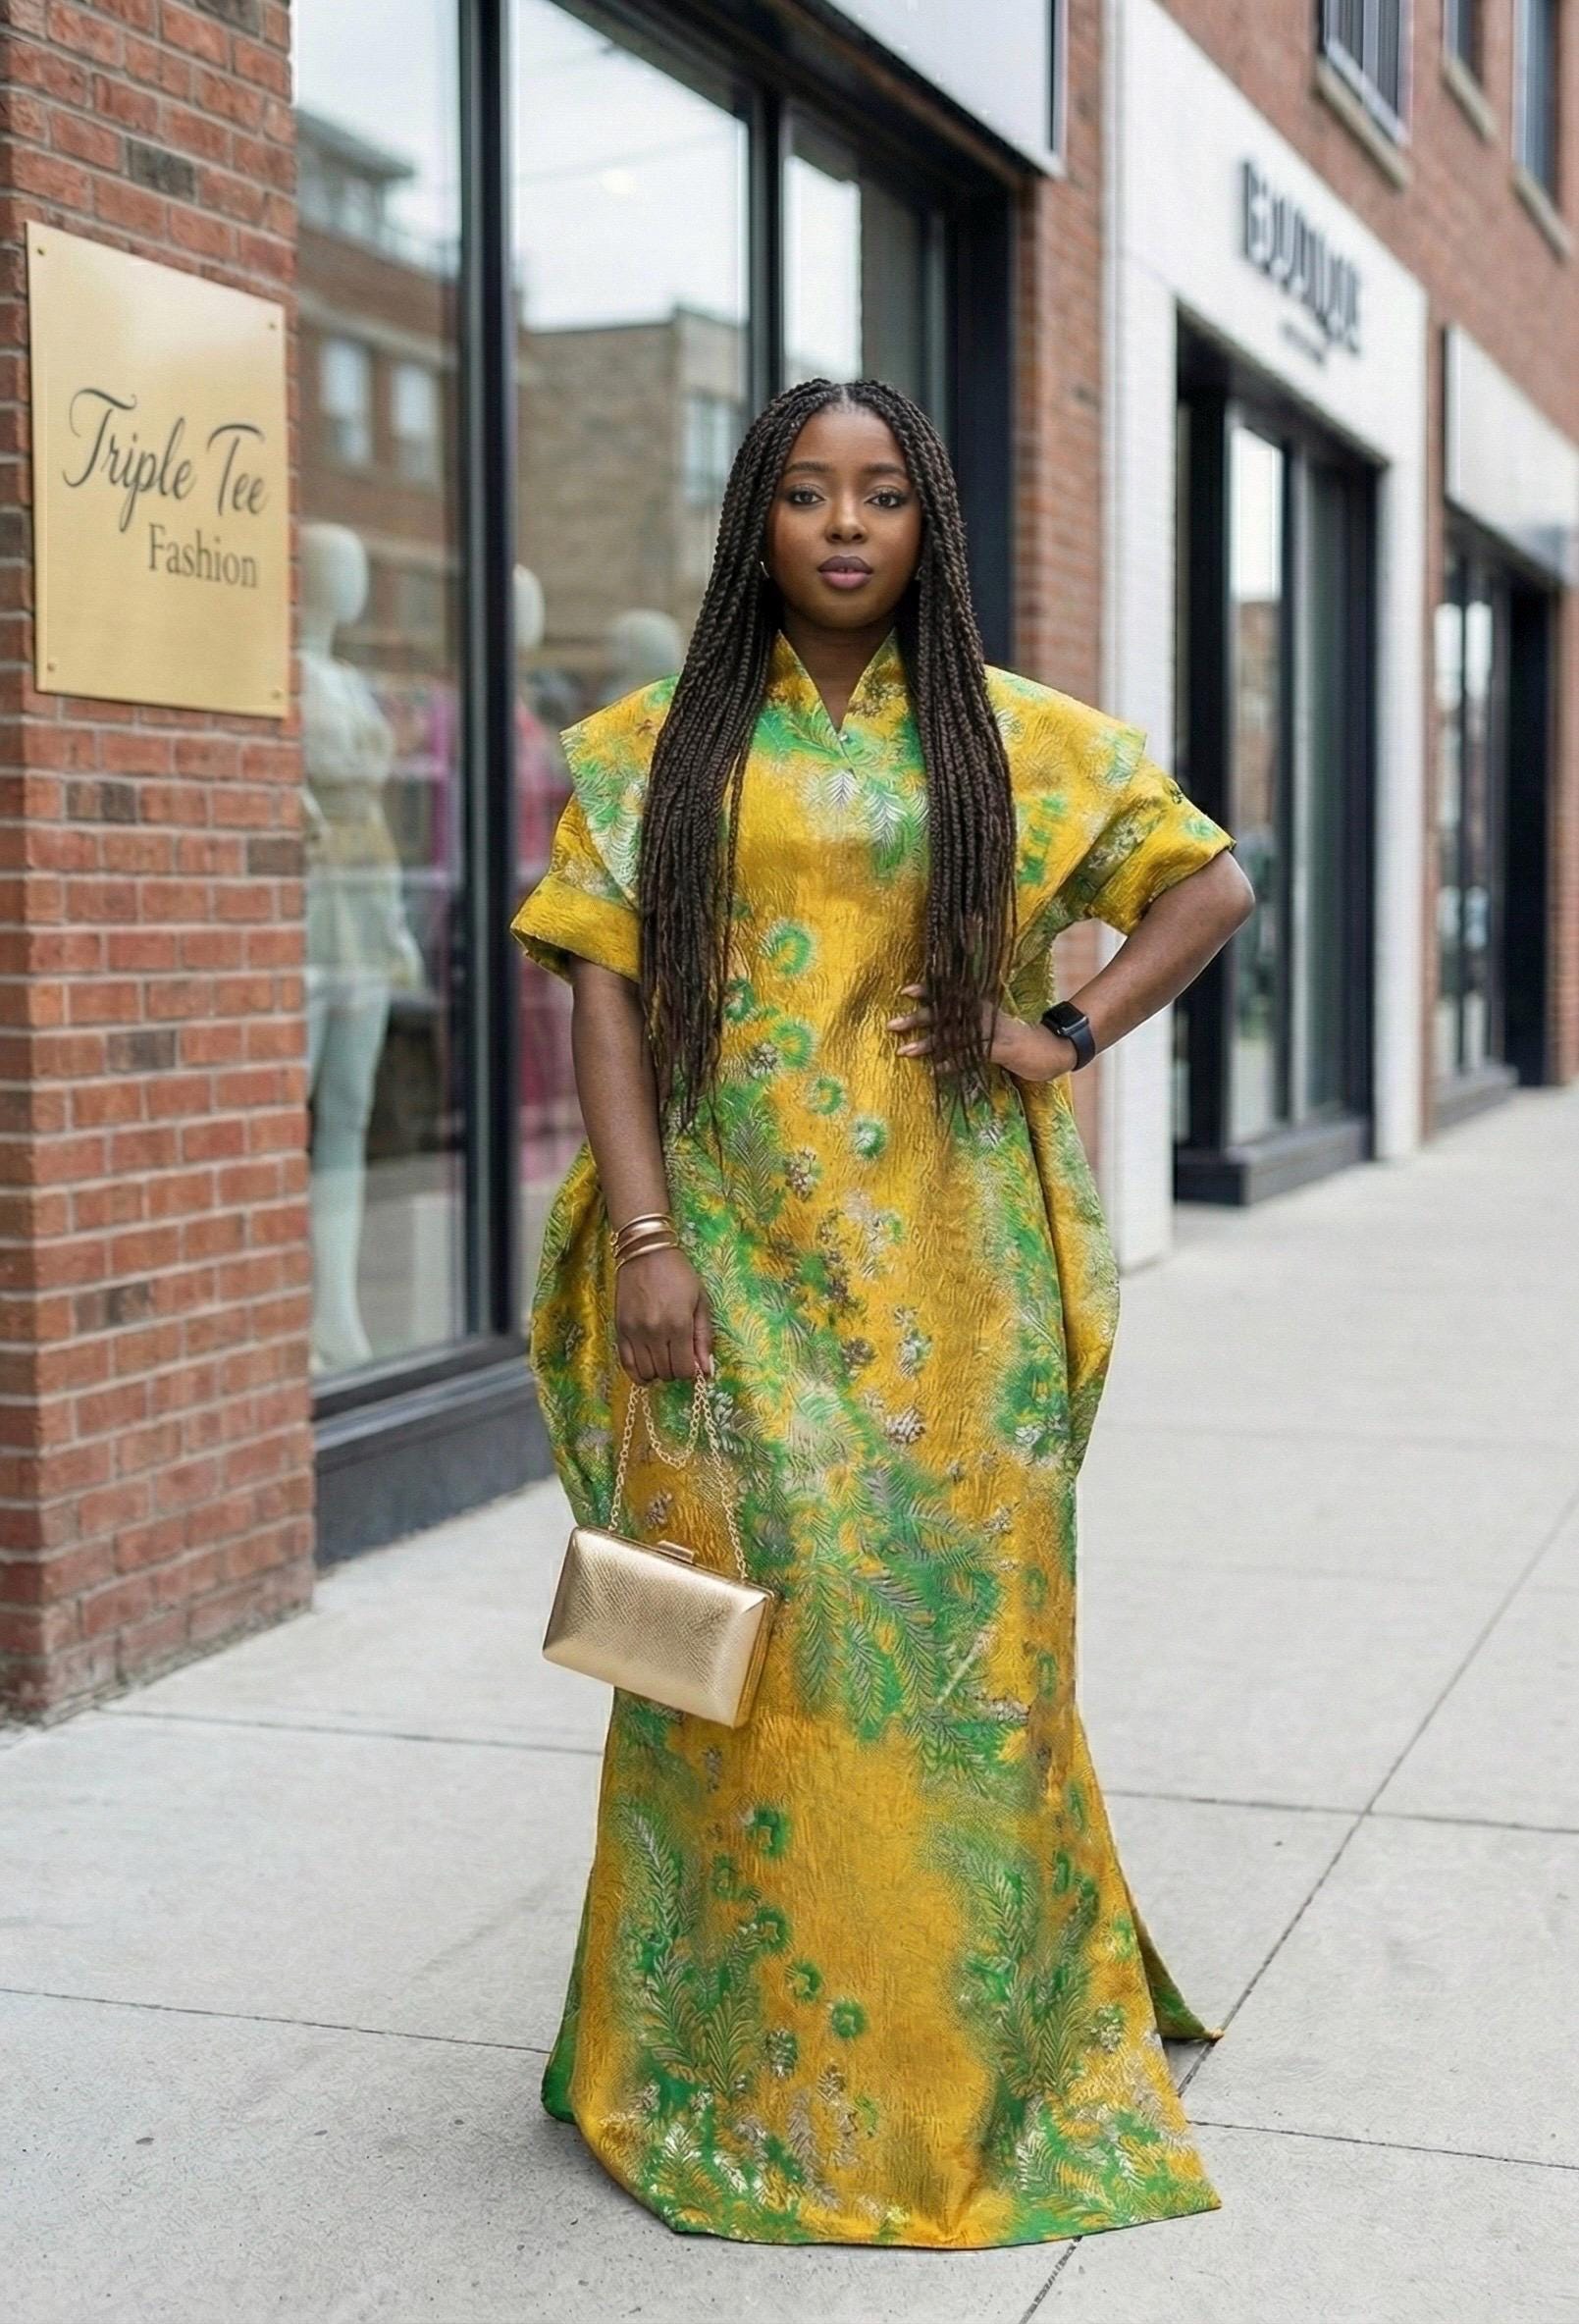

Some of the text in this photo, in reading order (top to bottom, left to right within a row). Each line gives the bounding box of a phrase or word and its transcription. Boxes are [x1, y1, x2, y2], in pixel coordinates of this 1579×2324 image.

[63, 388, 268, 533] Triple Tee
[148, 523, 258, 588] Fashion
